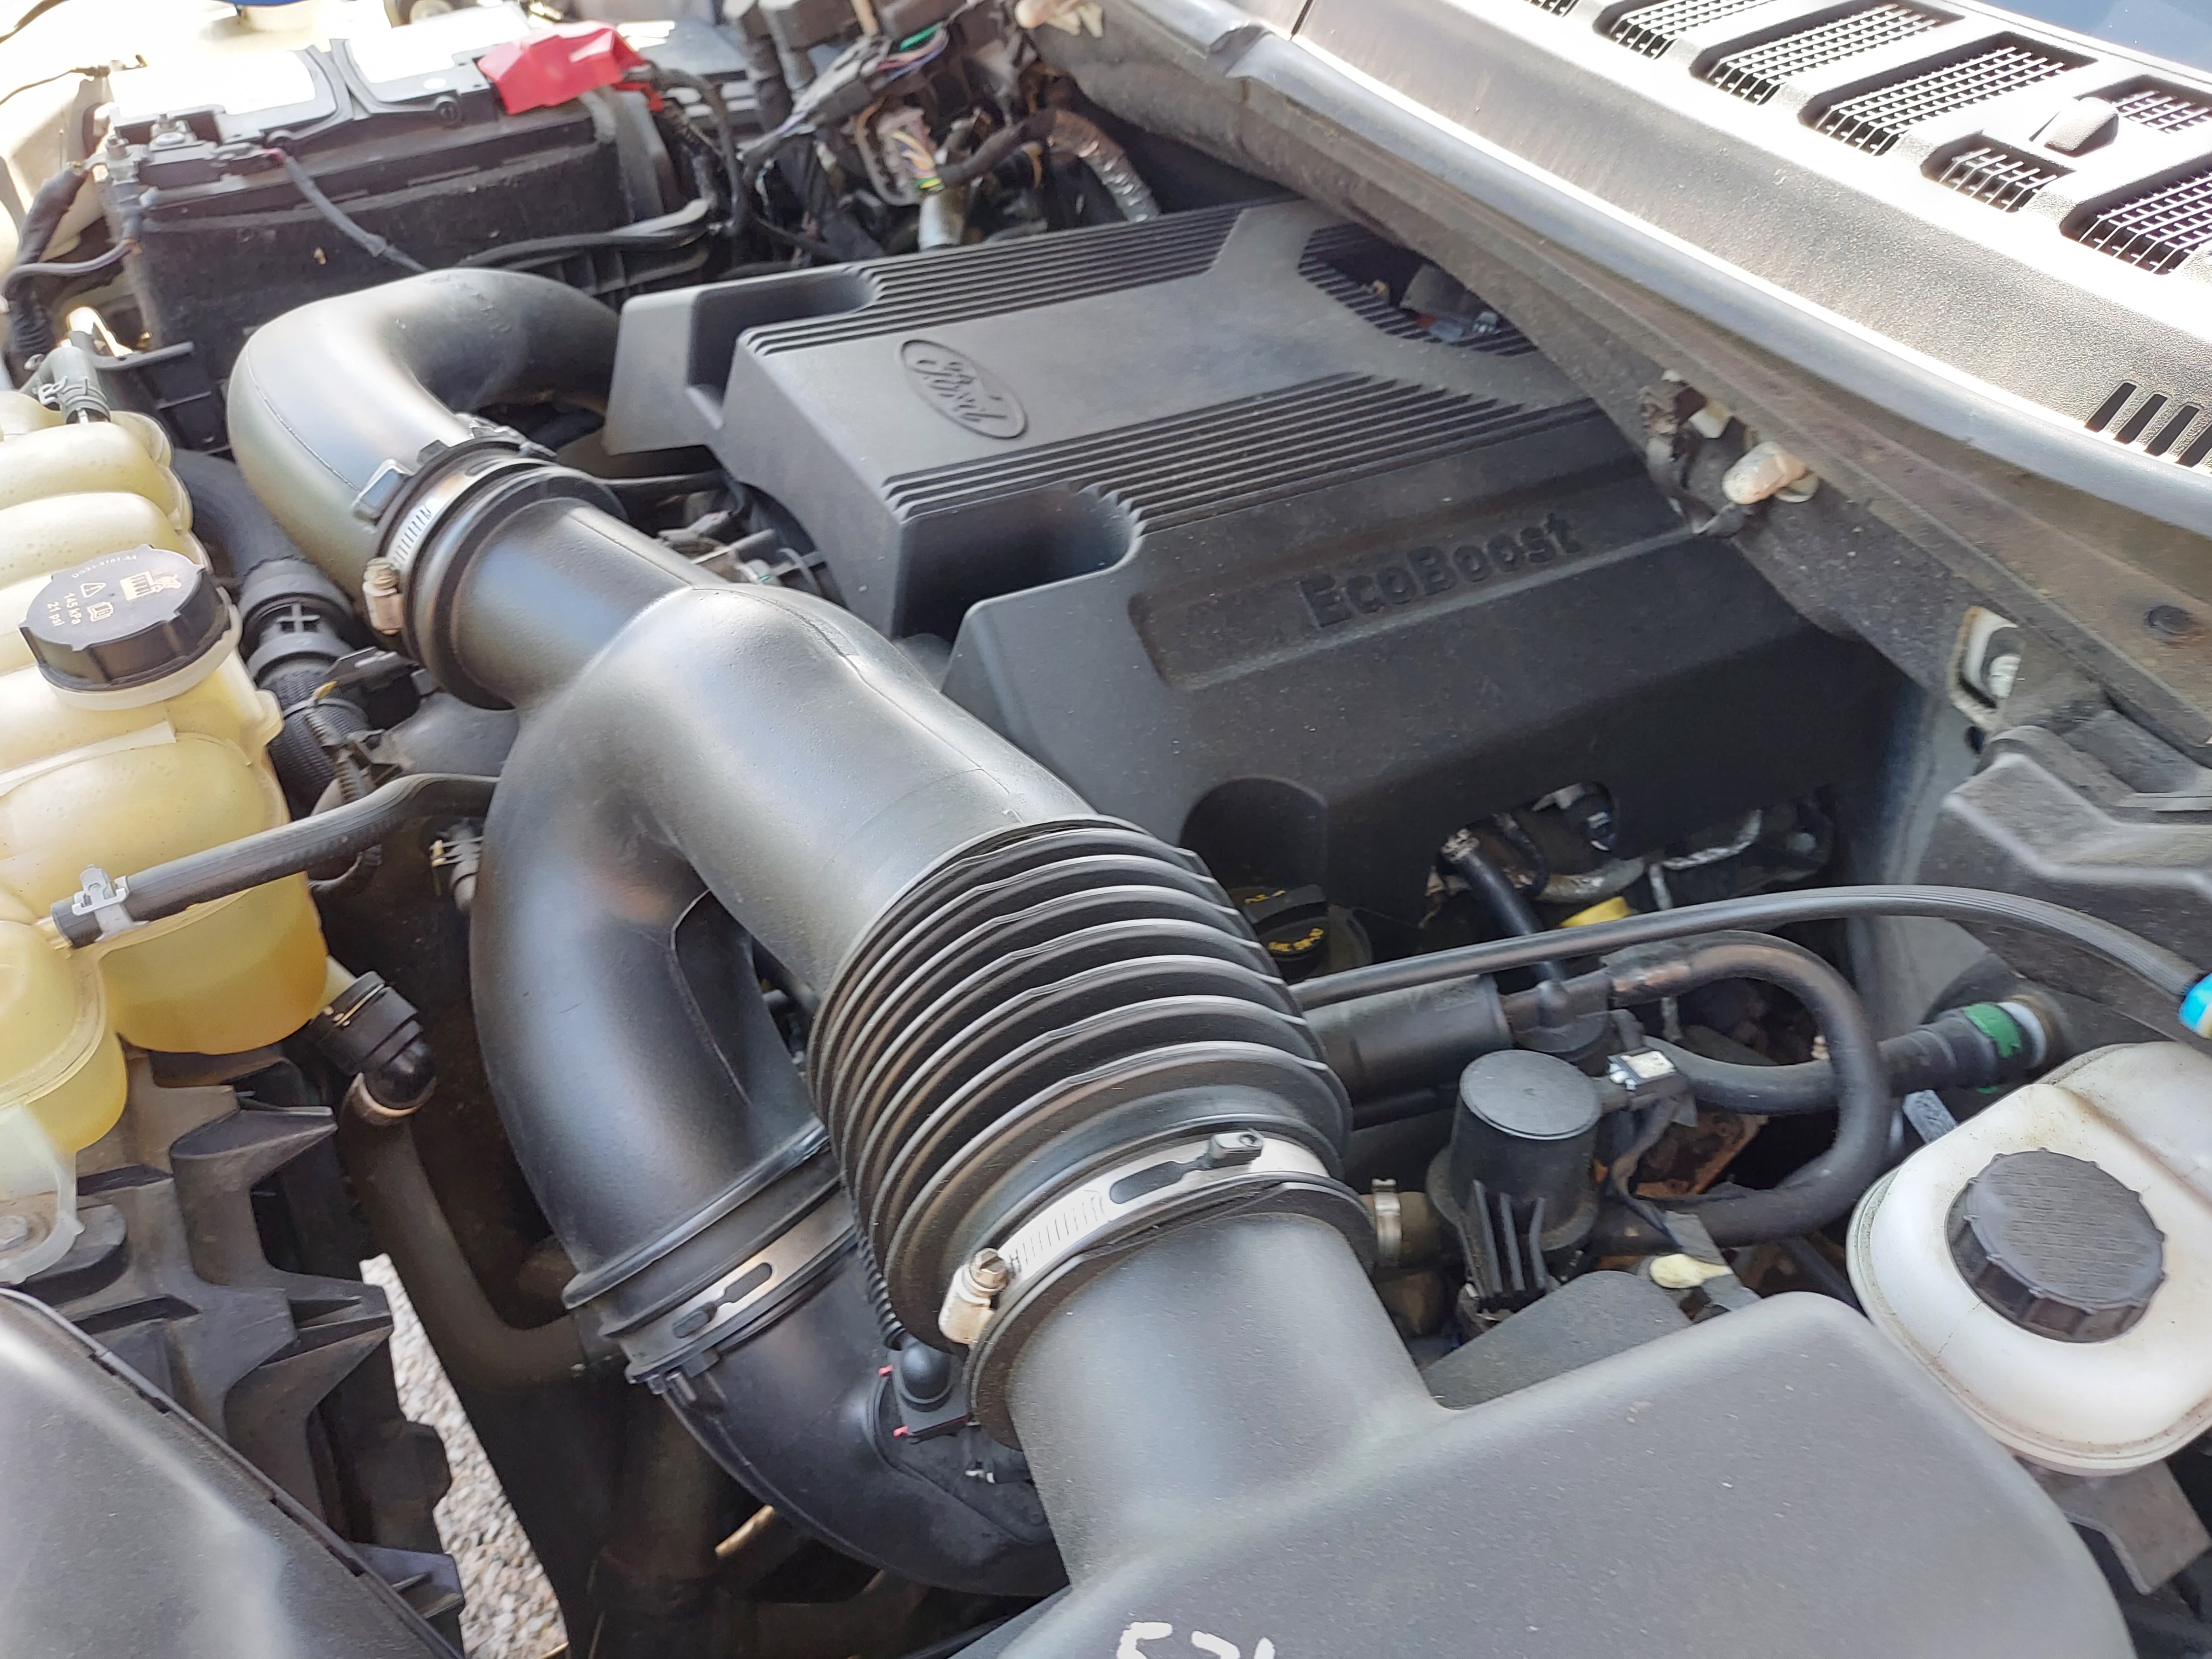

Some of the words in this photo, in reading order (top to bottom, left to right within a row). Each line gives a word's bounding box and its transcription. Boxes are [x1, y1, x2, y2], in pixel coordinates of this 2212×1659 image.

[907, 354, 1011, 427] Ford
[1298, 513, 1582, 629] EcoBoost
[47, 602, 61, 613] 21
[64, 593, 79, 608] 145
[49, 613, 65, 627] psi
[69, 608, 82, 625] kPa
